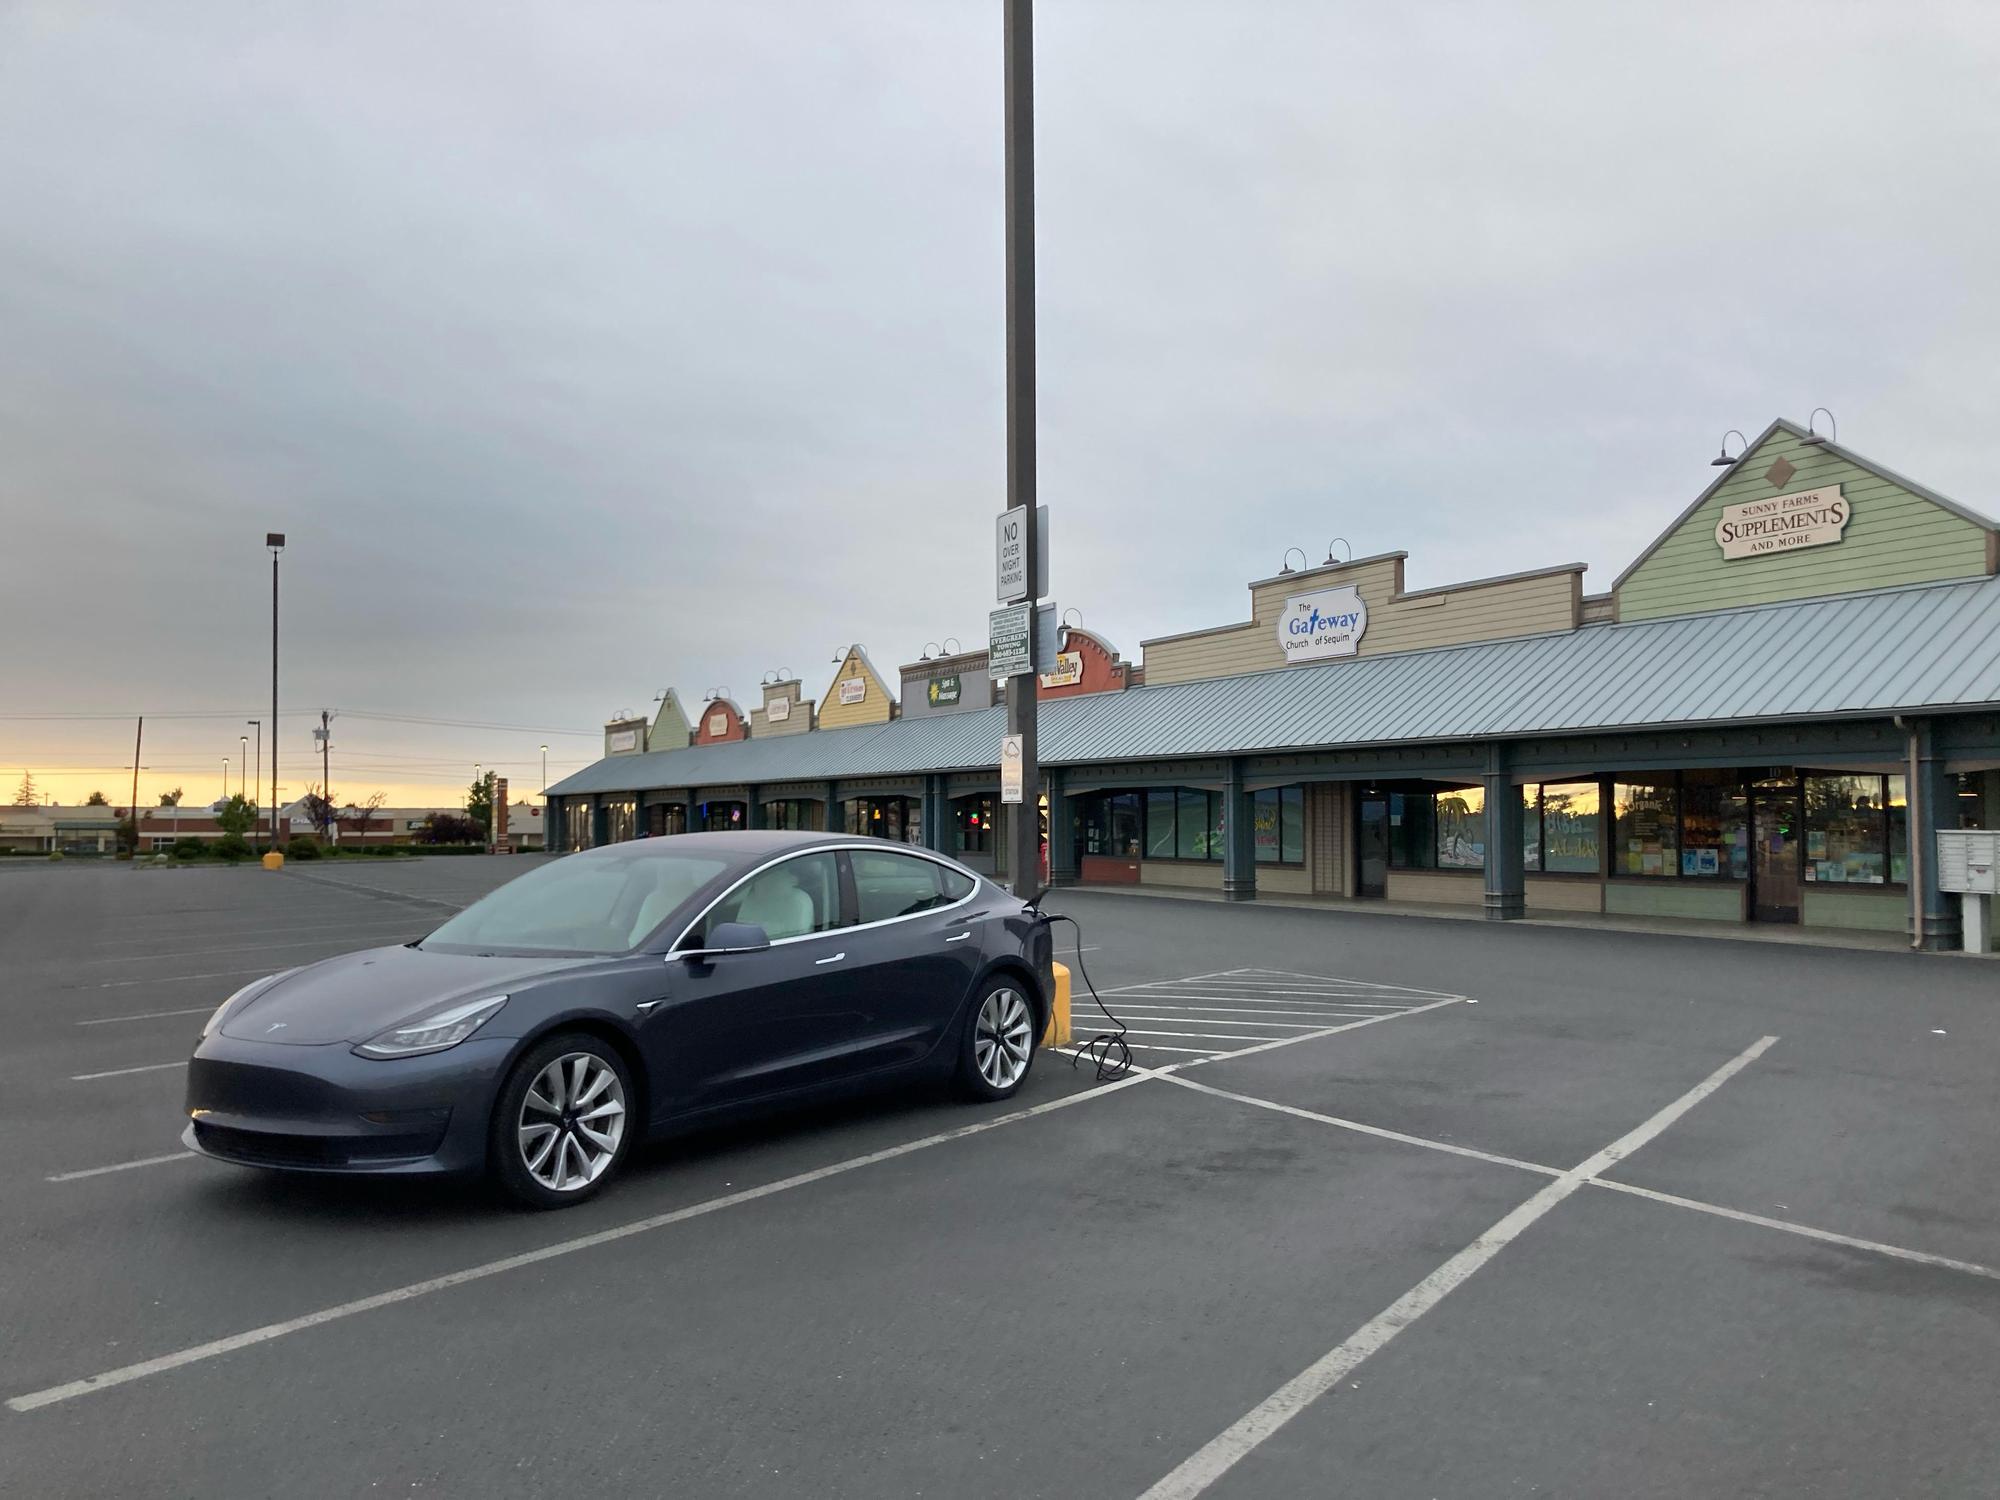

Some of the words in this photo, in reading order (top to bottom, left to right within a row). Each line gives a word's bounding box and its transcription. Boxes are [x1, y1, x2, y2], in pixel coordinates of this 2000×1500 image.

[1741, 502, 1779, 516] SUNNY
[1782, 493, 1820, 509] FARMS
[1722, 502, 1844, 543] SUPPLEMENTS
[1004, 522, 1018, 543] NO
[1003, 544, 1019, 558] OVER
[1750, 540, 1774, 552] AND
[1778, 534, 1811, 548] MORE
[1002, 557, 1020, 572] NIGHT
[1000, 571, 1022, 587] PARKING
[1298, 603, 1311, 613] The
[1289, 608, 1360, 635] Gateway
[991, 631, 1028, 646] EVERGREEN
[997, 641, 1021, 651] TOWING
[1286, 639, 1309, 650] Church
[1315, 635, 1323, 646] of
[1323, 633, 1350, 645] Sequim
